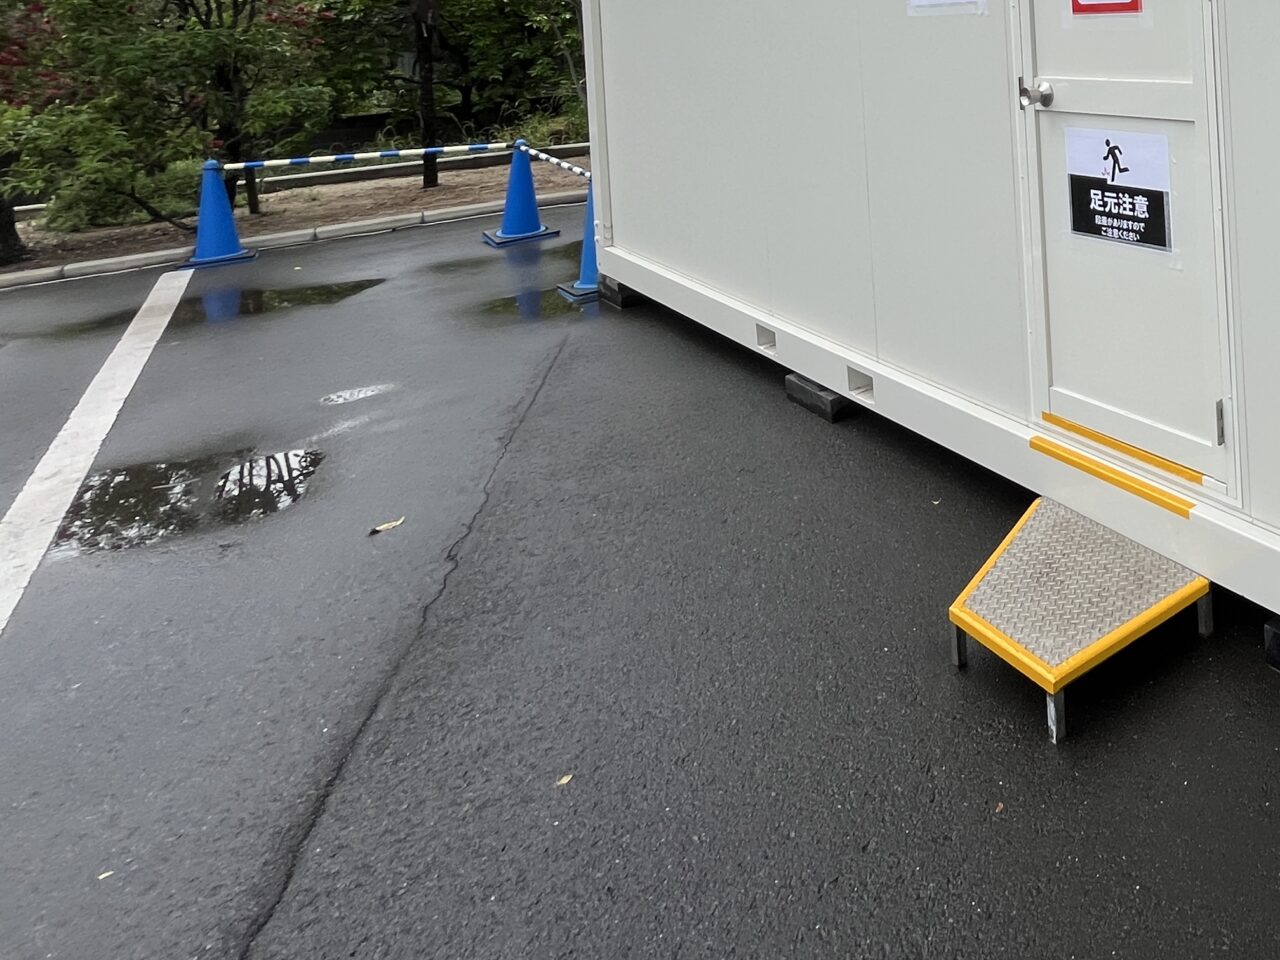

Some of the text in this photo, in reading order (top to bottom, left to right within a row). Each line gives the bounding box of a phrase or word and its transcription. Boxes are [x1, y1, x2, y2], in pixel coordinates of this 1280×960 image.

[1089, 189, 1150, 218] 足元注意
[1101, 226, 1140, 241] ご注意ください
